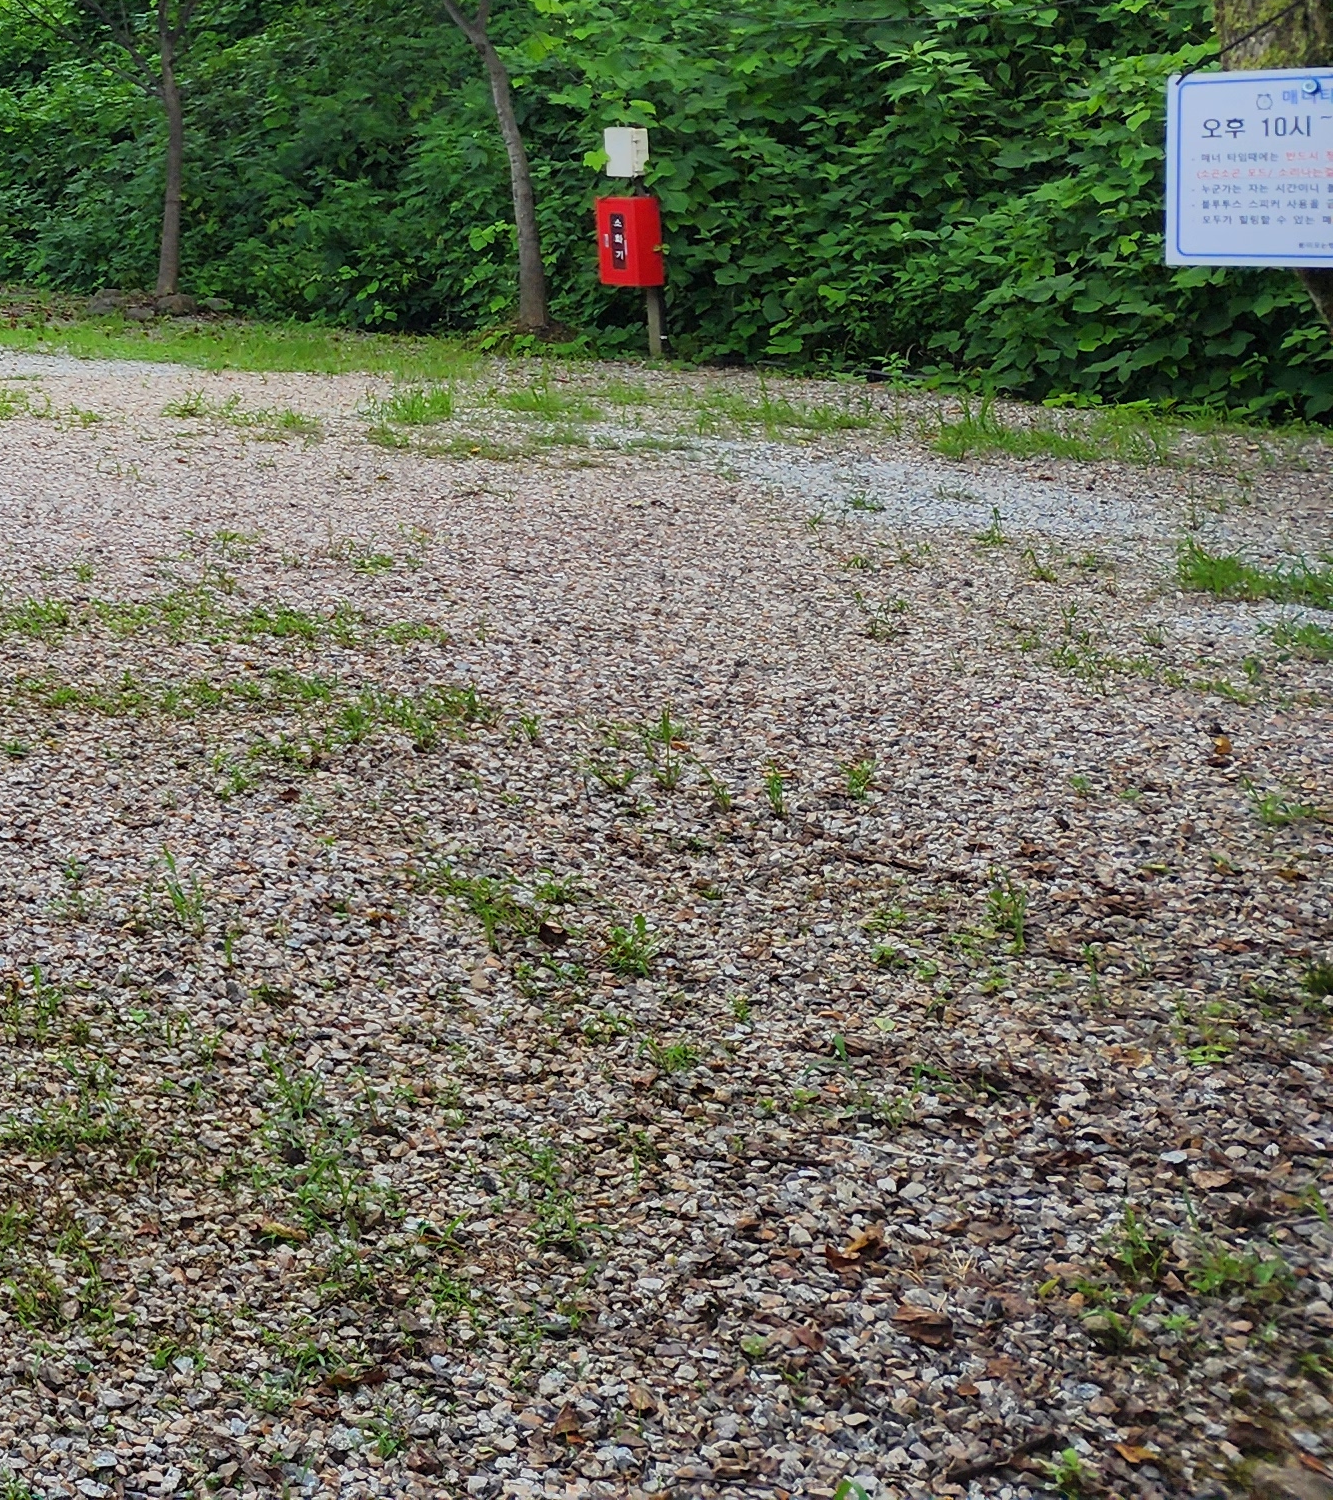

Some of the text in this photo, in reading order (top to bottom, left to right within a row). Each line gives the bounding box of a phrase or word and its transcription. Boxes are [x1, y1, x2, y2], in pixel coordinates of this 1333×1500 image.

[1201, 118, 1246, 139] 오후
[1261, 115, 1311, 137] 10시
[1201, 153, 1221, 163] 매너
[1285, 151, 1319, 161] 반드시
[1202, 184, 1242, 194] 누군가는
[1248, 183, 1269, 193] 자는
[1275, 183, 1320, 194] 시간이니
[1248, 199, 1281, 210] 스피커
[1287, 199, 1319, 210] 사용을
[1276, 215, 1287, 225] 수
[1293, 215, 1315, 225] 있는
[612, 218, 624, 261] 소화기
